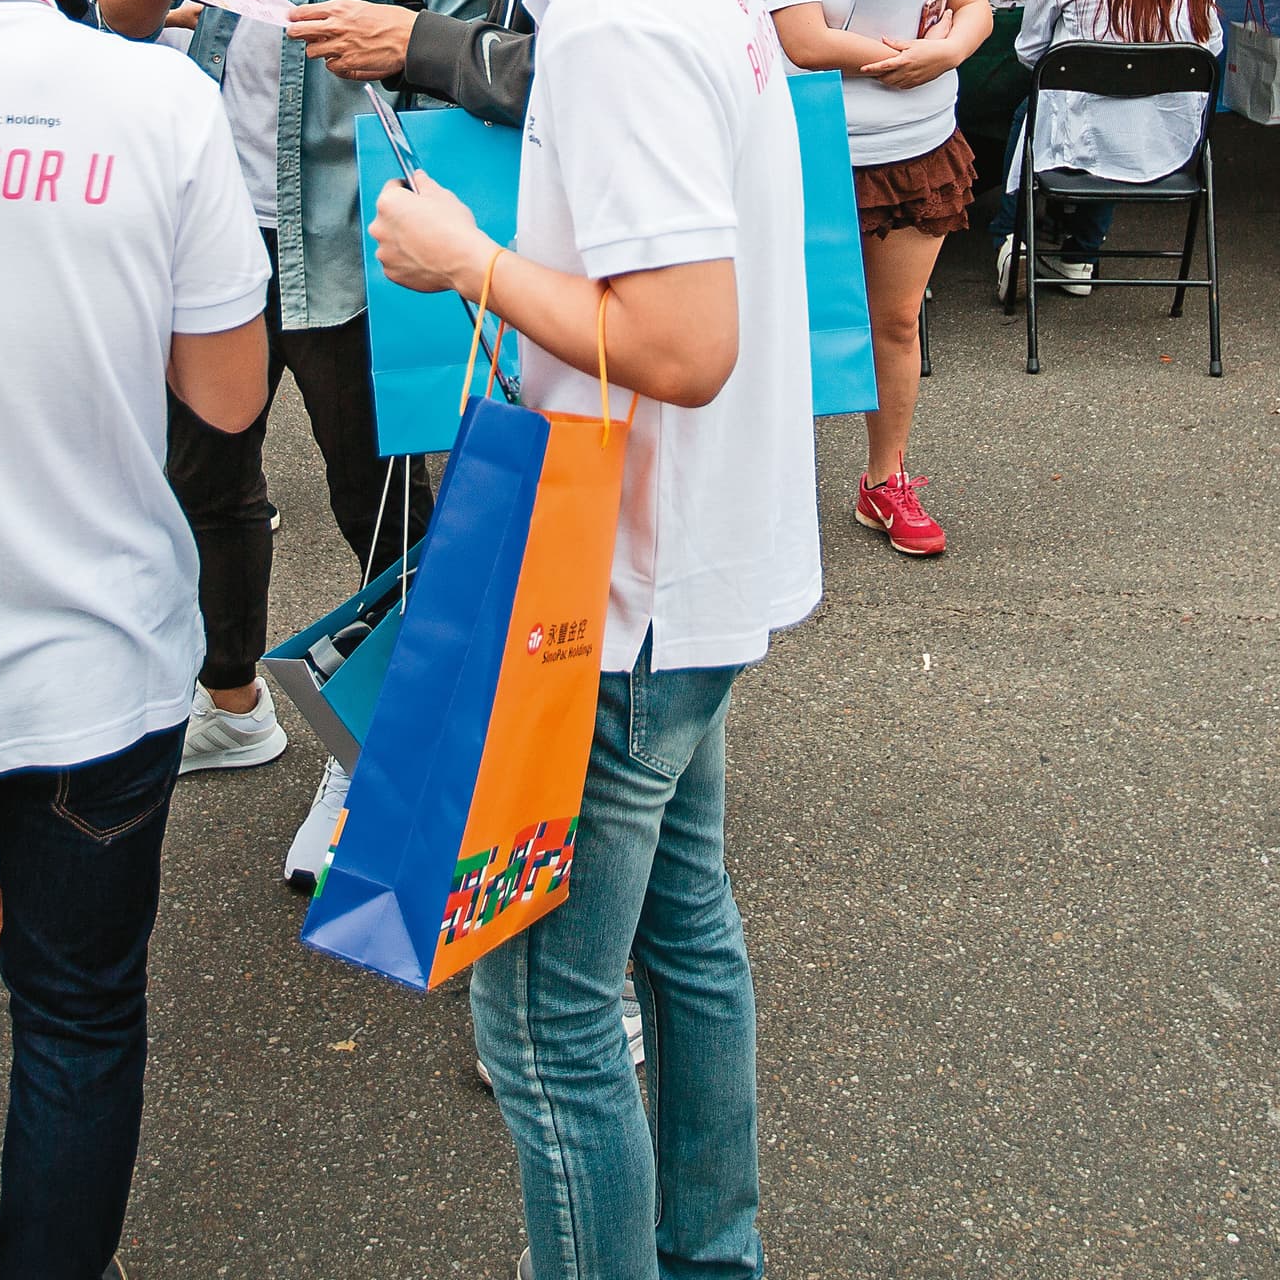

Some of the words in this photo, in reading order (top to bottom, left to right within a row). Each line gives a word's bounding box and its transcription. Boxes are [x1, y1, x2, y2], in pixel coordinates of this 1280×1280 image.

[6, 114, 61, 127] Holdings
[84, 153, 115, 205] U
[546, 619, 588, 646] 永豐金控
[542, 647, 566, 664] SinoPac
[568, 643, 593, 658] Holdings
